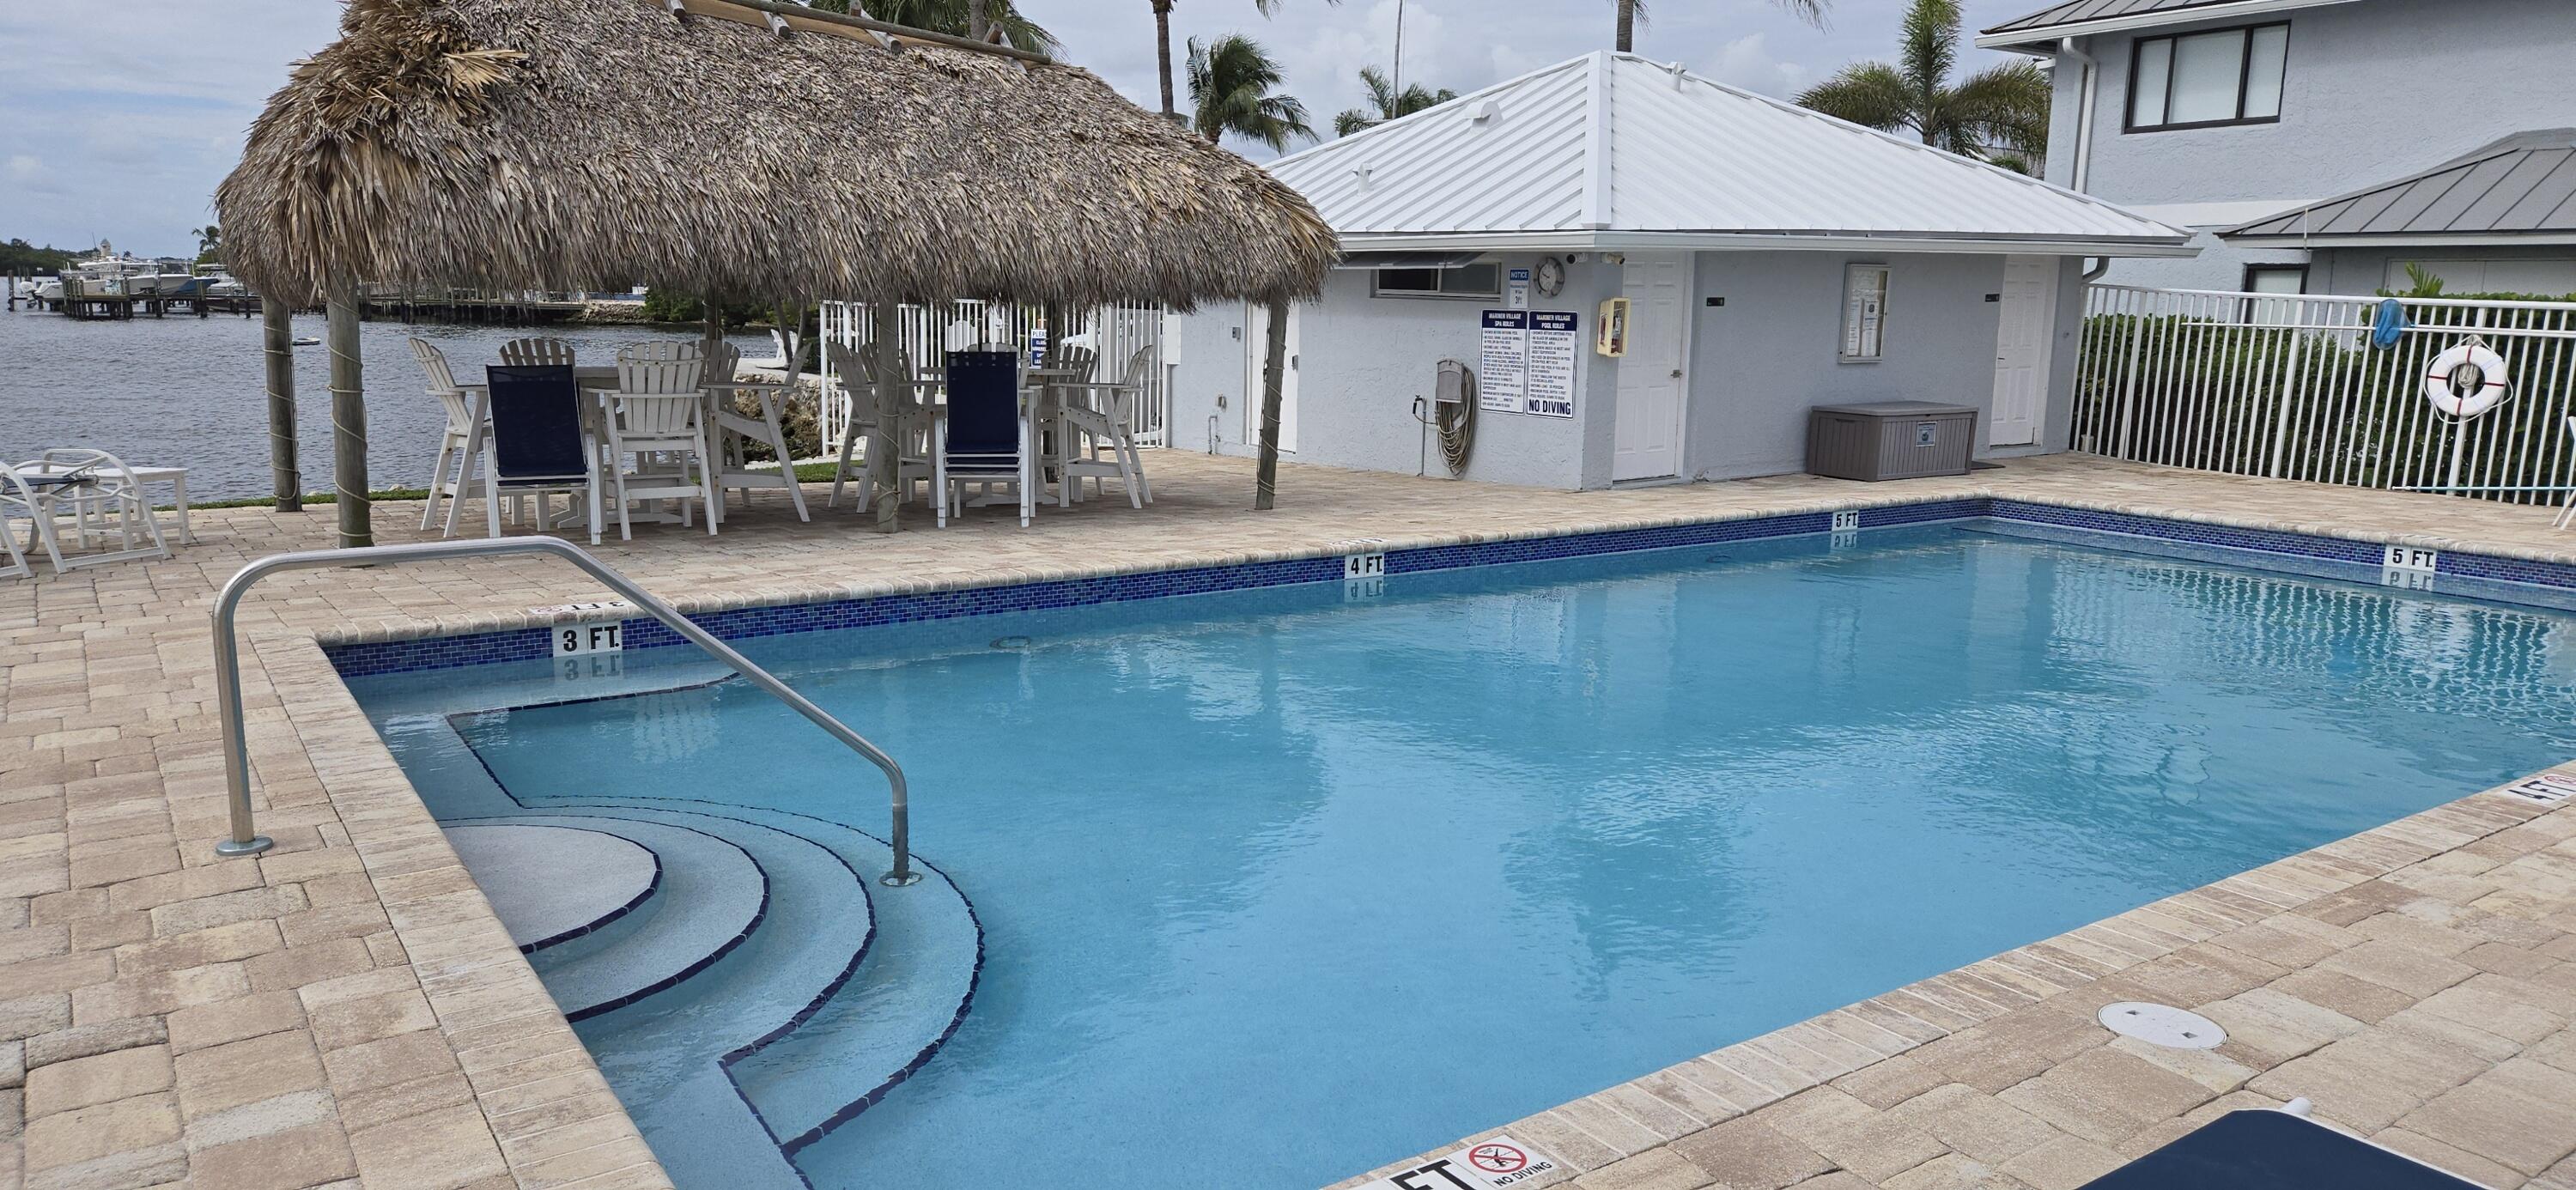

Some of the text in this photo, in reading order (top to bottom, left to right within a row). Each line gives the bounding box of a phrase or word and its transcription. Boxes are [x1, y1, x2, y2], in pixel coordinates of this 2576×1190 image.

[1528, 399, 1571, 415] NO DIVING
[1836, 514, 1842, 527] 5
[1351, 557, 1359, 574] 4
[2392, 548, 2433, 568] 5 FT.
[562, 625, 620, 653] 3 FT.
[1388, 1159, 1479, 1190] FT
[1493, 1161, 1552, 1187] NO DIVING
